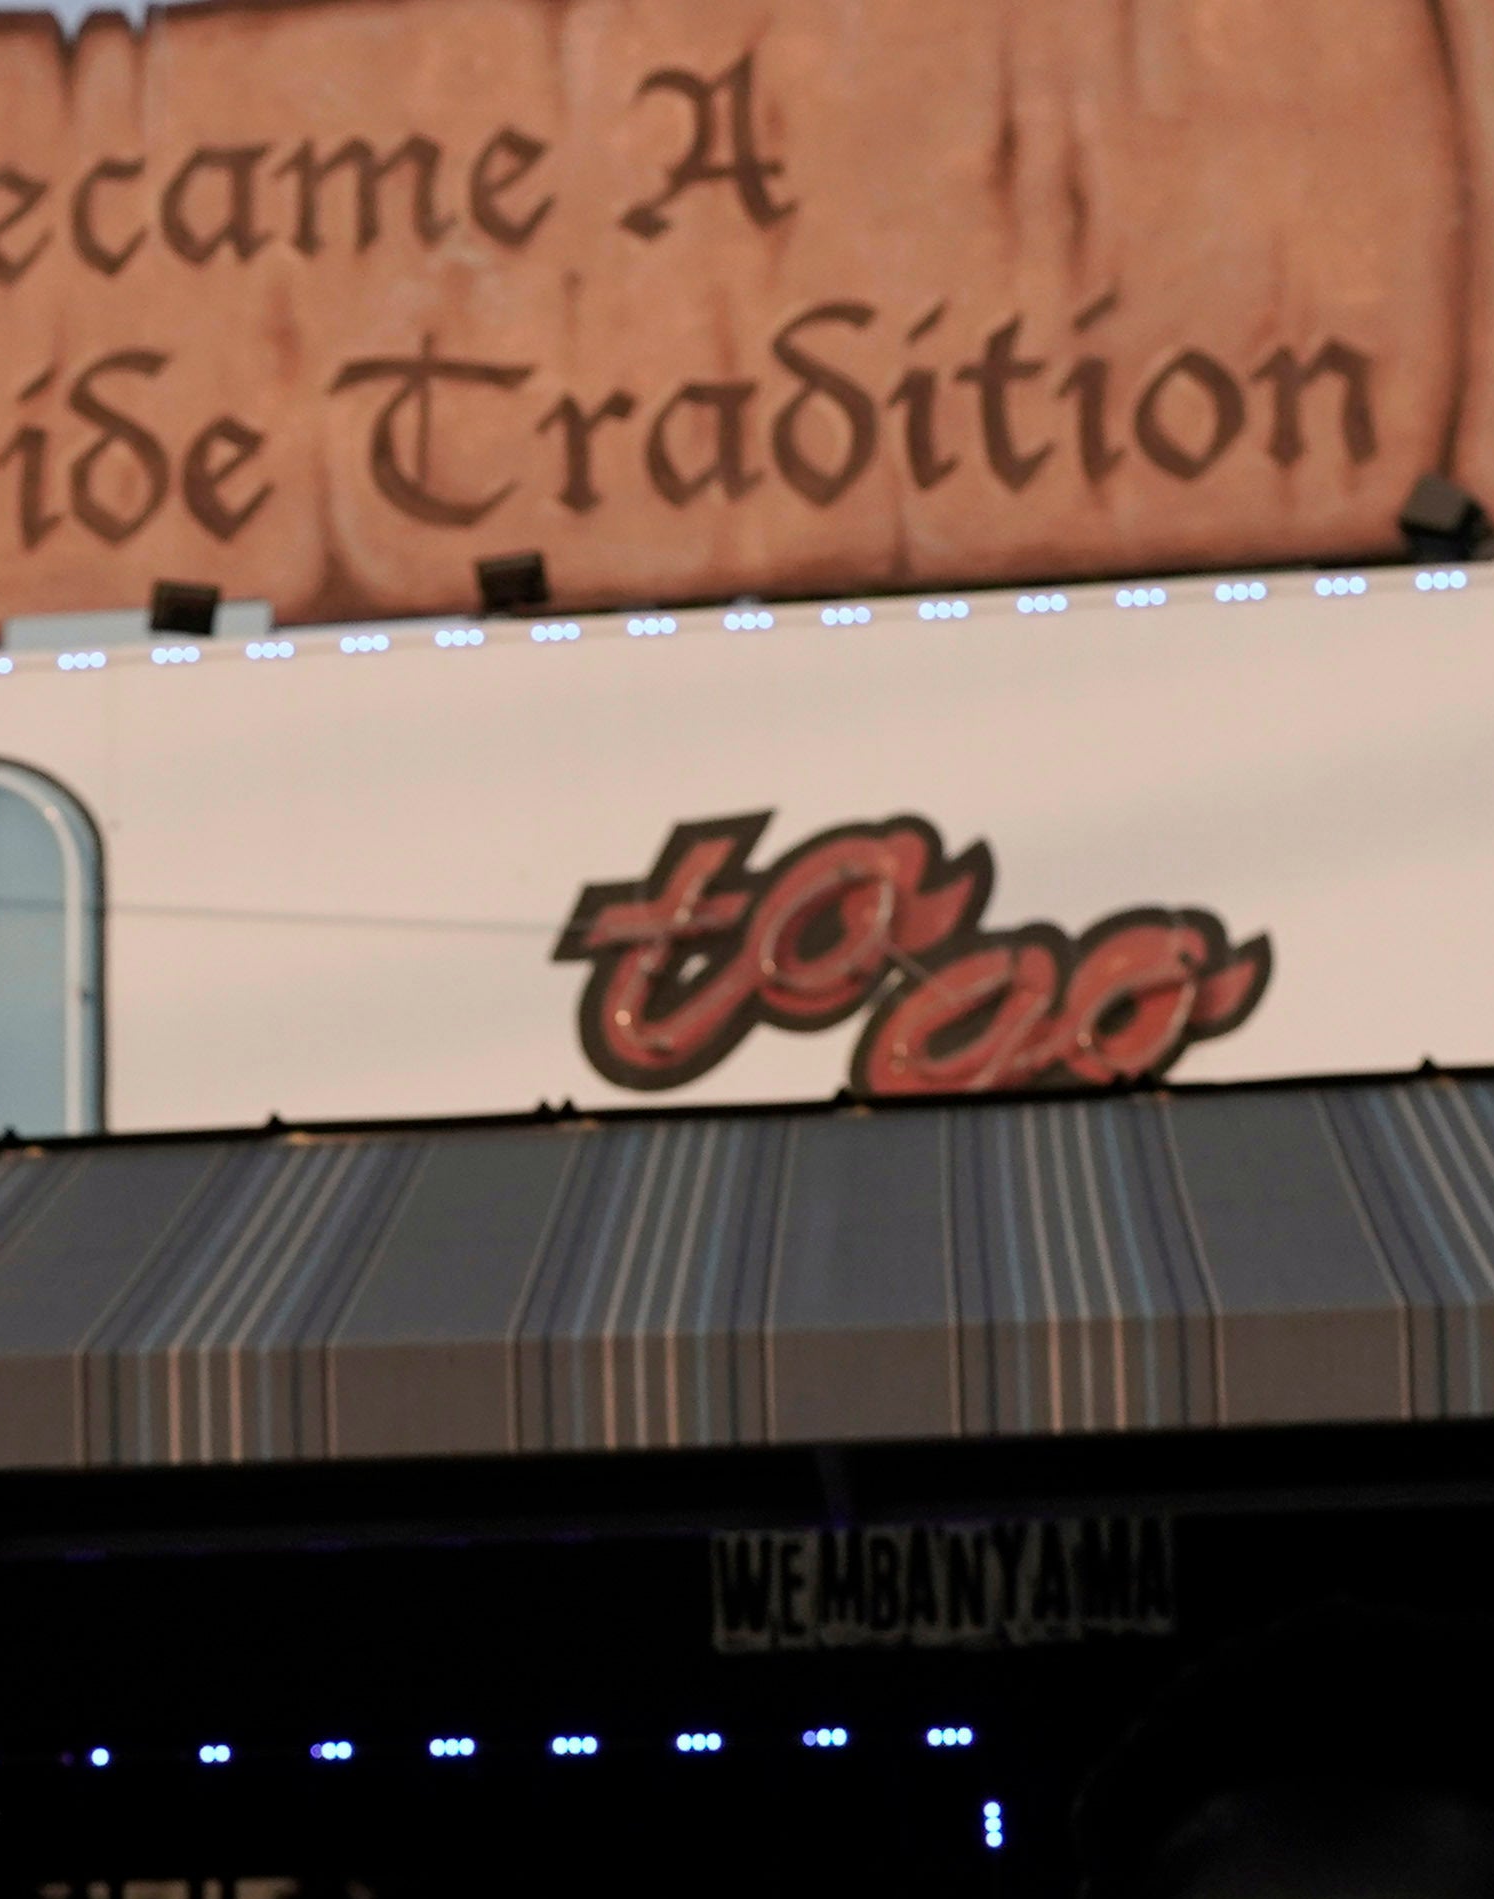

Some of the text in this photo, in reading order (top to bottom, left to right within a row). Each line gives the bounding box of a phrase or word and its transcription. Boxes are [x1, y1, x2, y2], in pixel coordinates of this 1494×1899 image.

[613, 48, 800, 243] A
[327, 292, 1390, 530] Tradition
[550, 808, 996, 1092] to
[711, 1513, 1180, 1656] WEMBANYAMA
